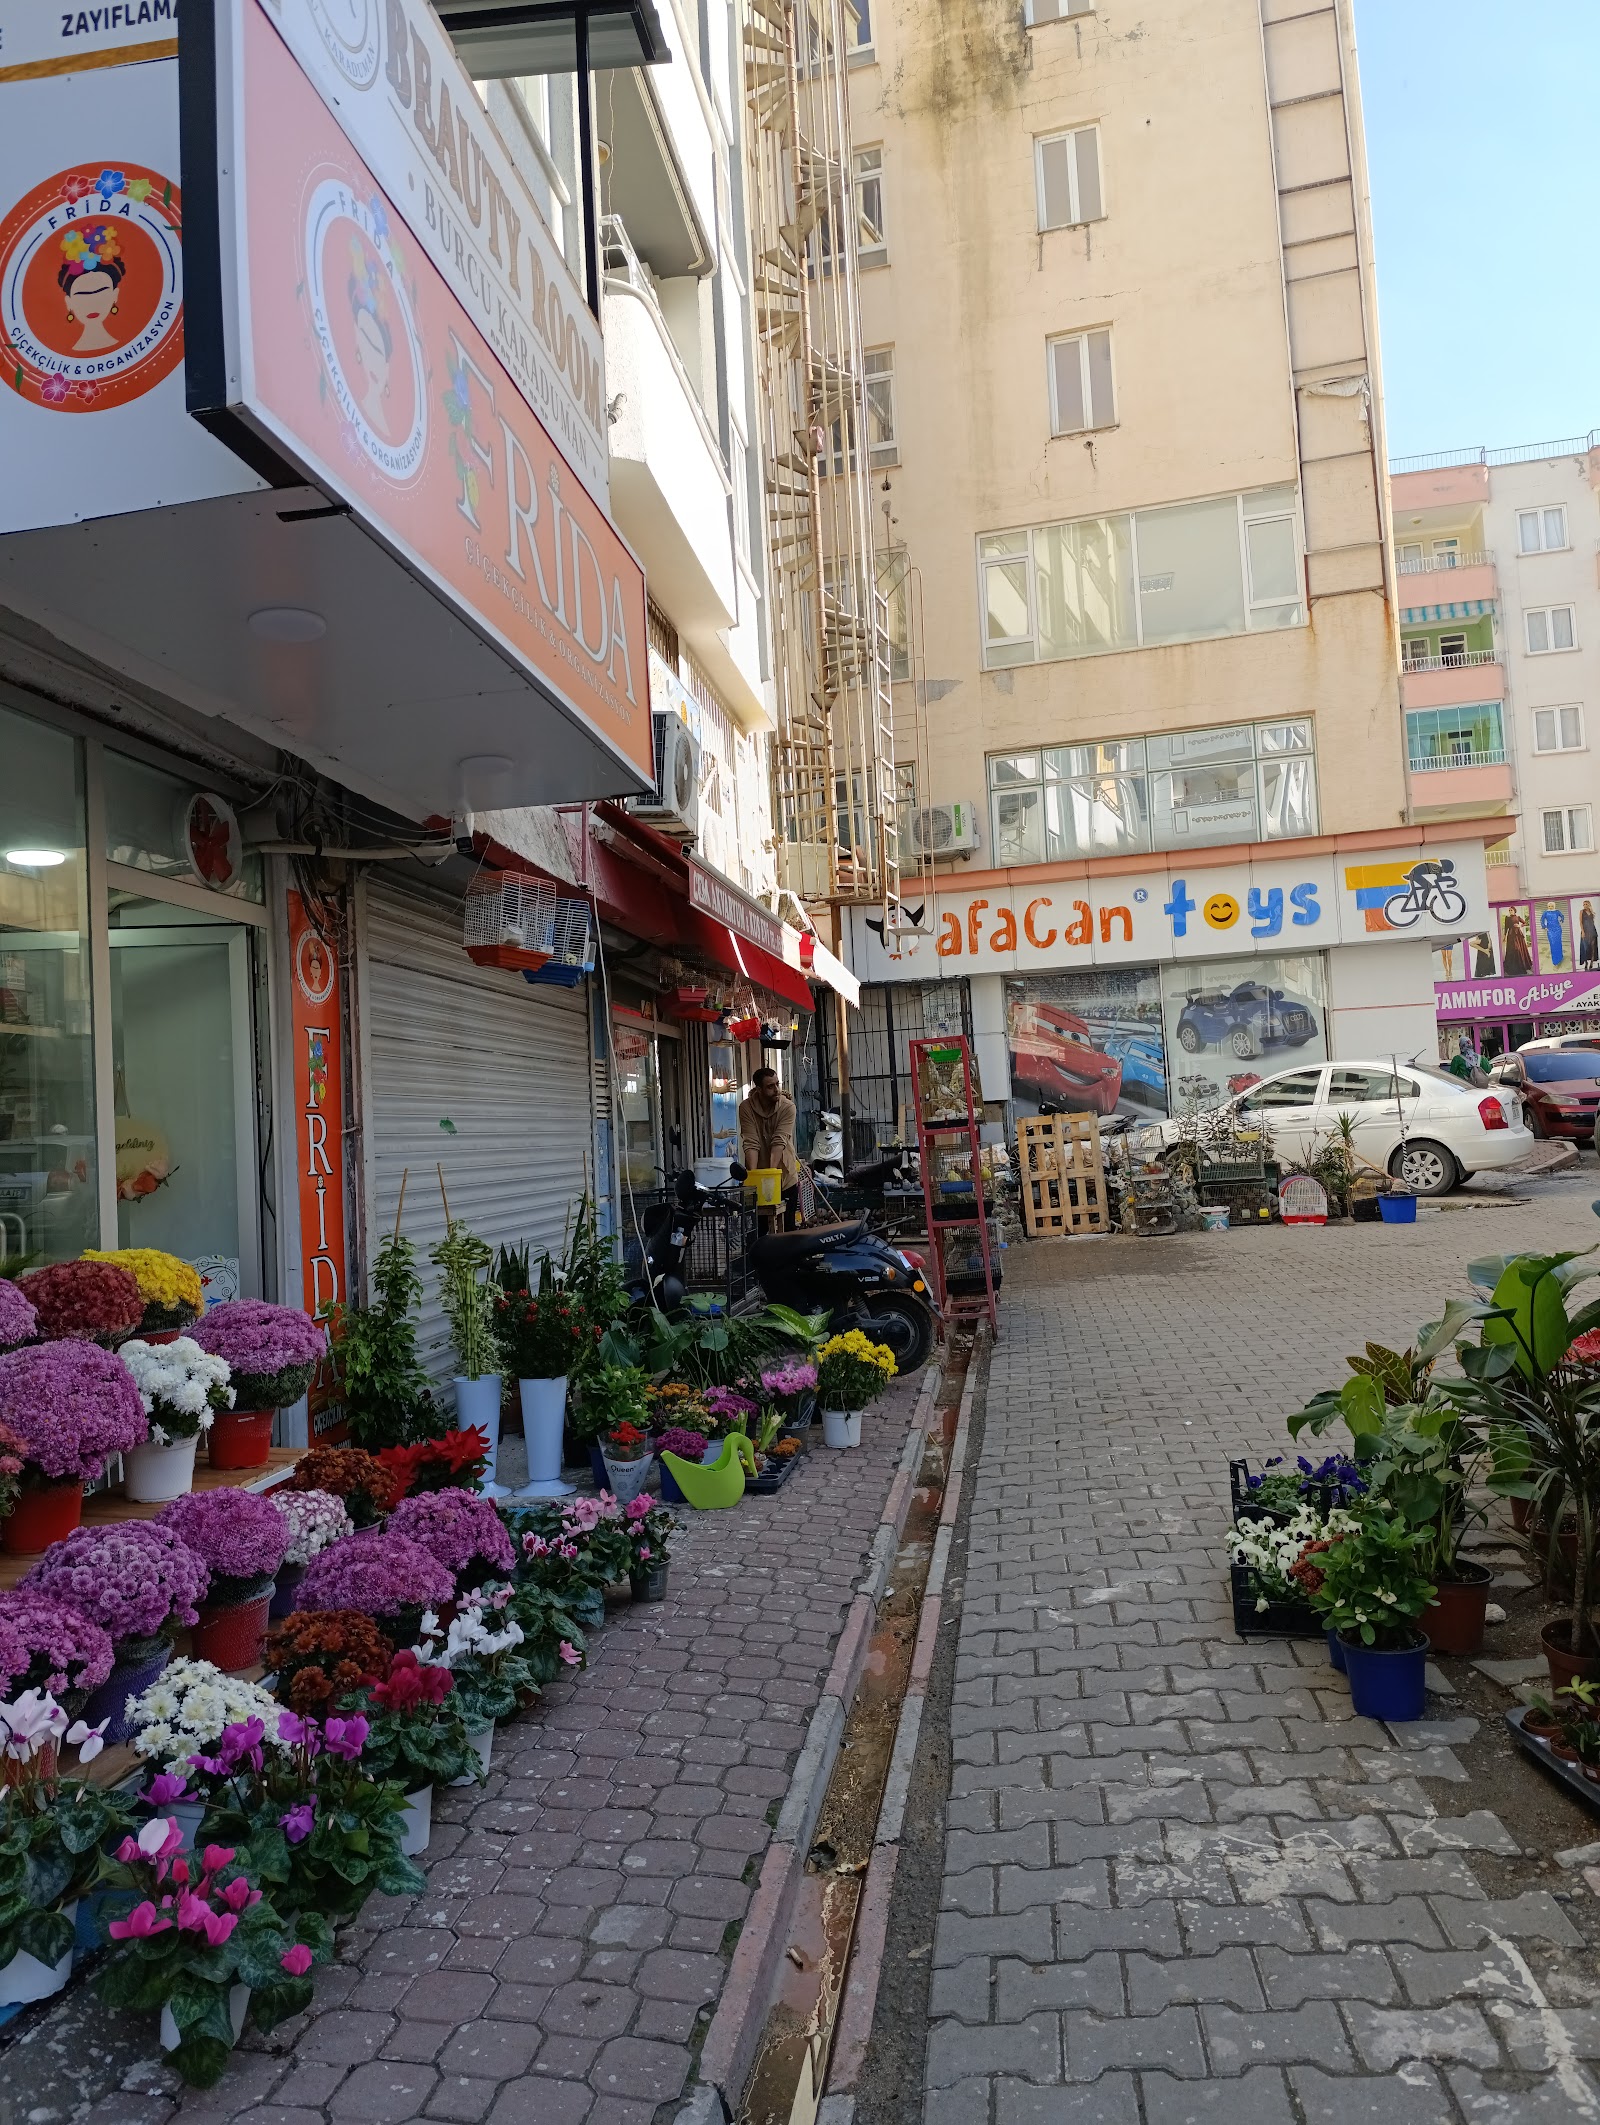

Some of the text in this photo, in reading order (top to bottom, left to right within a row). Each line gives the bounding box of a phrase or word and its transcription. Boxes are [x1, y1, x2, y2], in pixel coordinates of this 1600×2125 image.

[62, 0, 178, 37] ZAYIFLAM
[48, 199, 131, 230] FRİDA
[385, 0, 521, 301] BEAUTY
[527, 236, 603, 440] ROOM
[11, 327, 70, 374] ÇİÇEKÇİLİK
[86, 301, 175, 374] ORGANİZASYON
[424, 179, 492, 315] BURCU
[496, 296, 588, 470] KARADUMAN
[449, 328, 638, 706] FRİDA
[465, 537, 547, 638] ÇİÇEKÇİLİK
[559, 638, 632, 727] ORGANİZASYON
[1519, 980, 1574, 1011] Abiye
[819, 1232, 846, 1244] VOLTA
[610, 1465, 635, 1473] Queen
